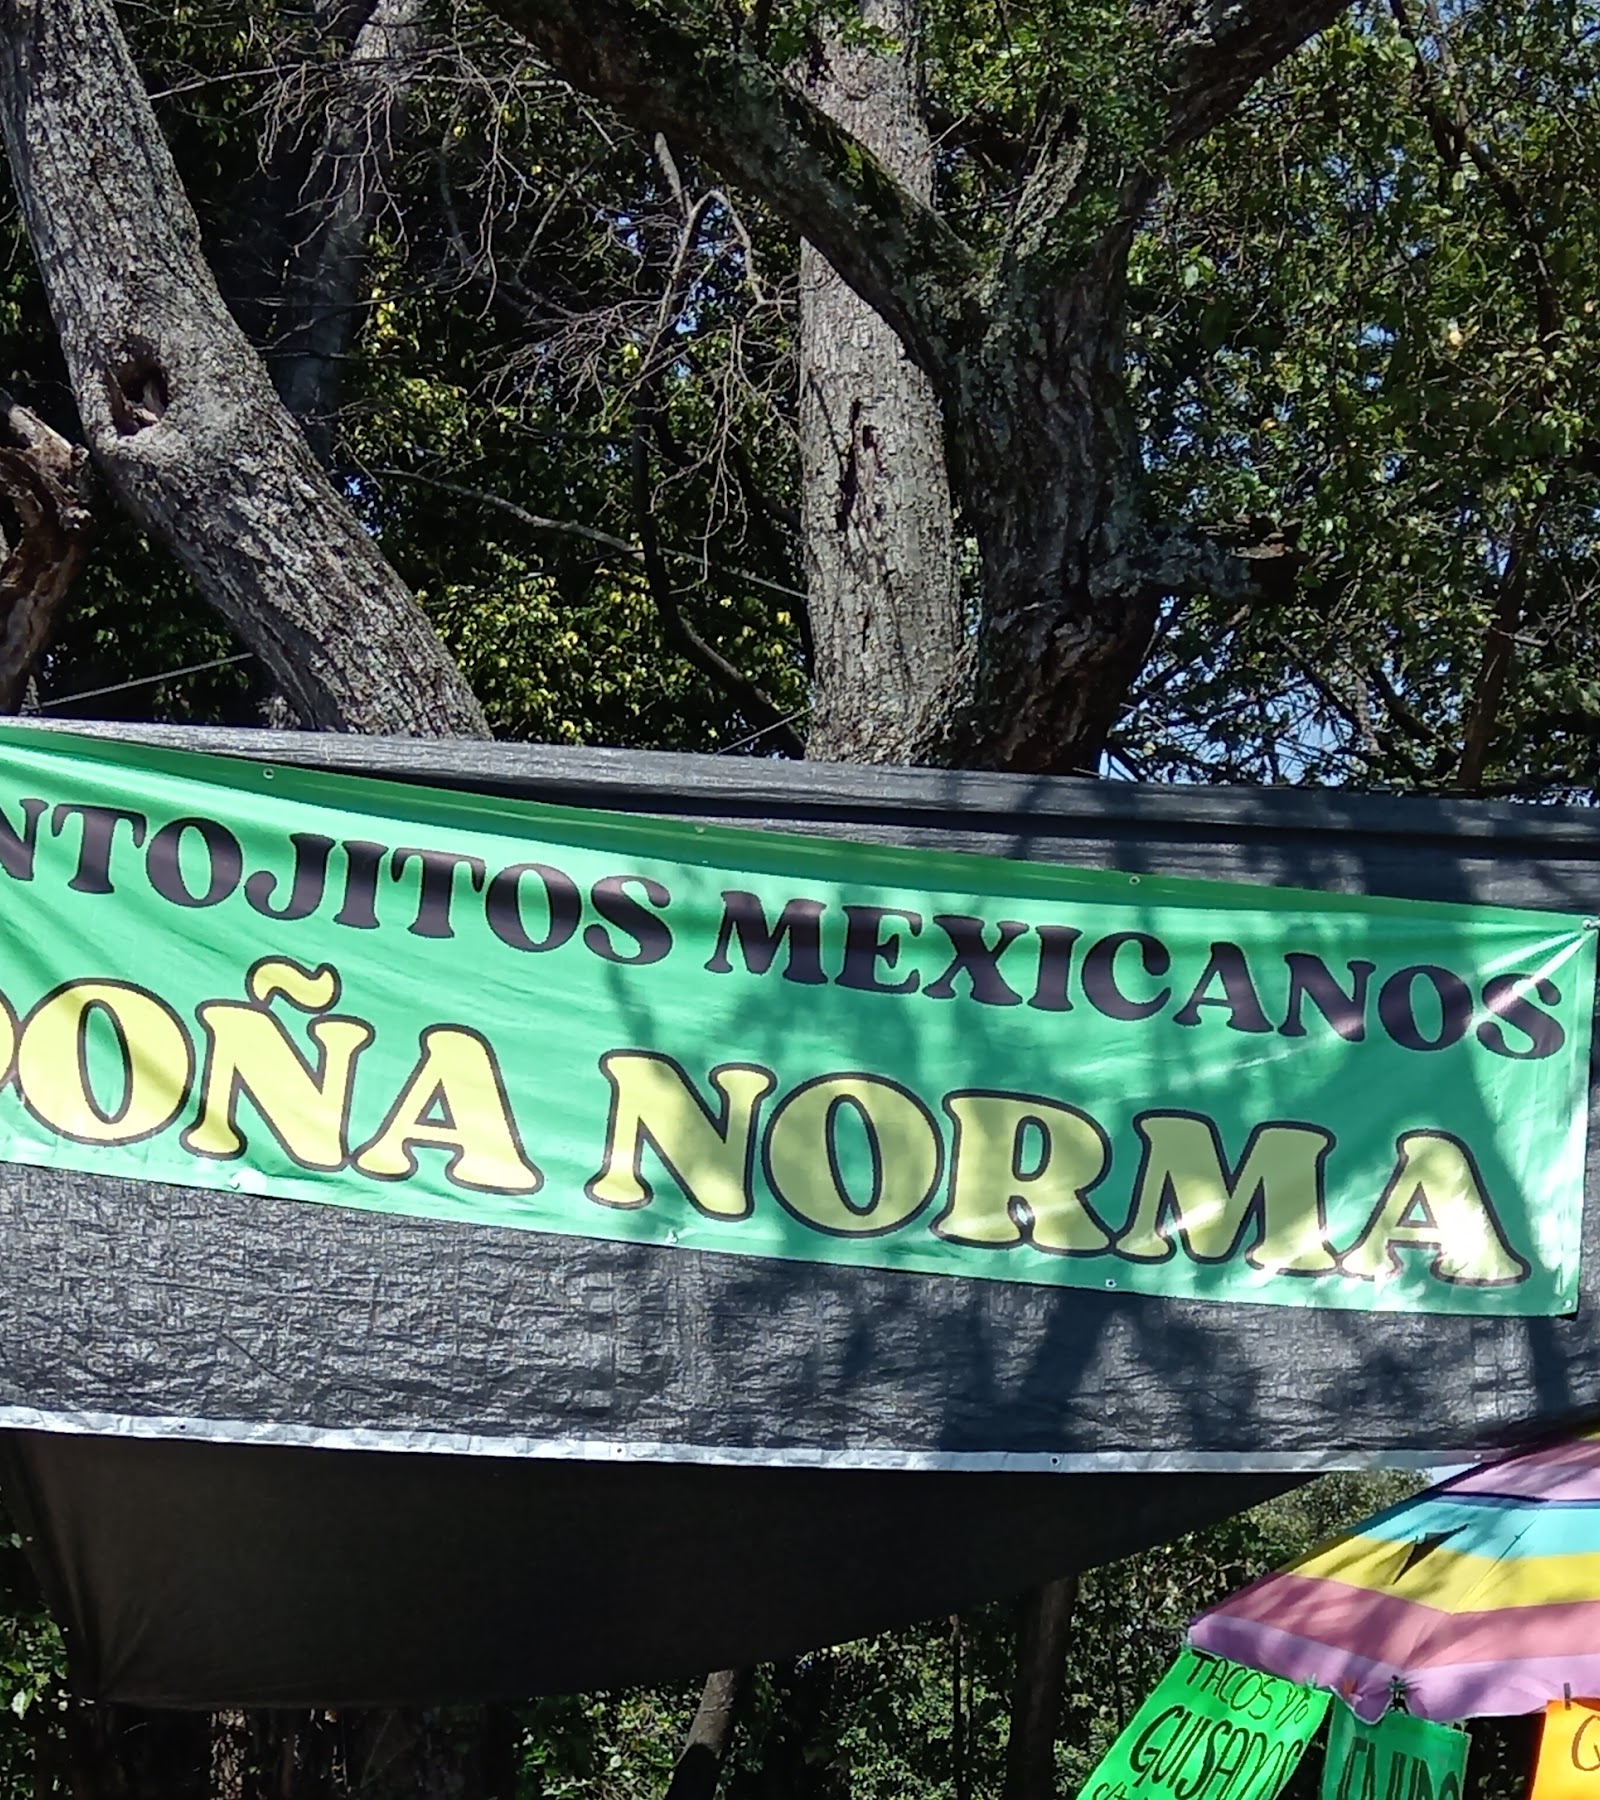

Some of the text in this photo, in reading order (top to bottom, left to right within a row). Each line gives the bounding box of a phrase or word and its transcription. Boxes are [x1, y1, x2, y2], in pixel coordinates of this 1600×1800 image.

[704, 888, 1567, 1061] MEXICANOS
[586, 1048, 1532, 1287] NORMA
[1185, 1652, 1278, 1720] TACOS
